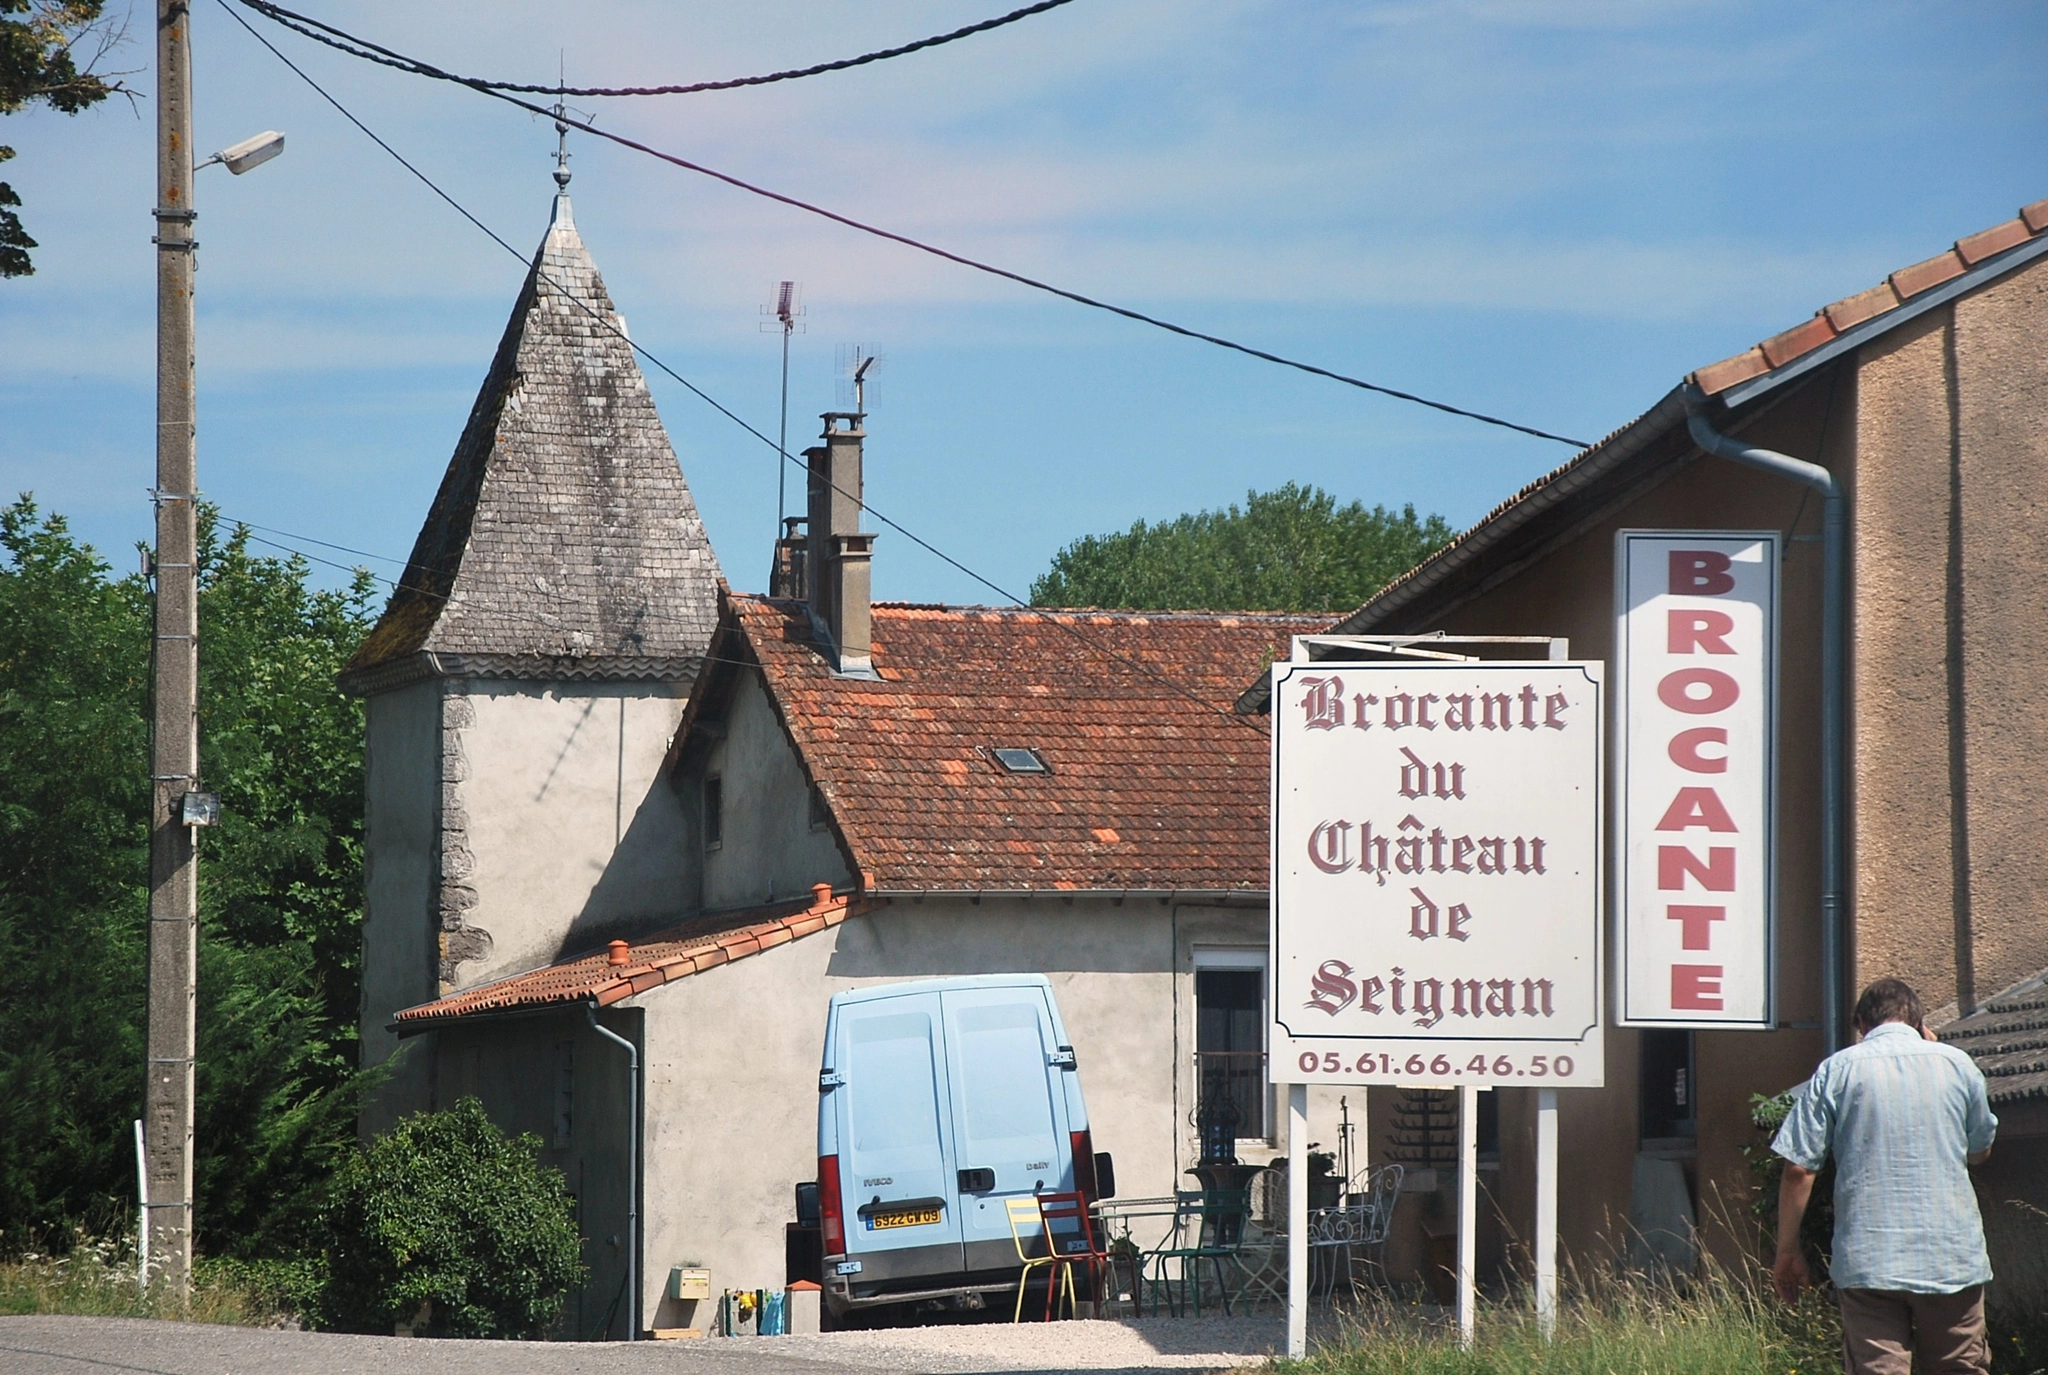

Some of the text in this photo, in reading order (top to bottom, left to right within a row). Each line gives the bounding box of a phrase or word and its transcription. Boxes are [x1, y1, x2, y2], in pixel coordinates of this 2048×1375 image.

[1300, 675, 1570, 731] Brocante
[1397, 746, 1466, 800] du
[1655, 550, 1740, 1011] BROCANTE
[1307, 814, 1547, 886] Château
[1407, 887, 1472, 941] de
[1303, 959, 1555, 1029] Seignan
[1299, 1051, 1574, 1077] 05.61.66.46.50
[863, 1177, 893, 1187] IVECO
